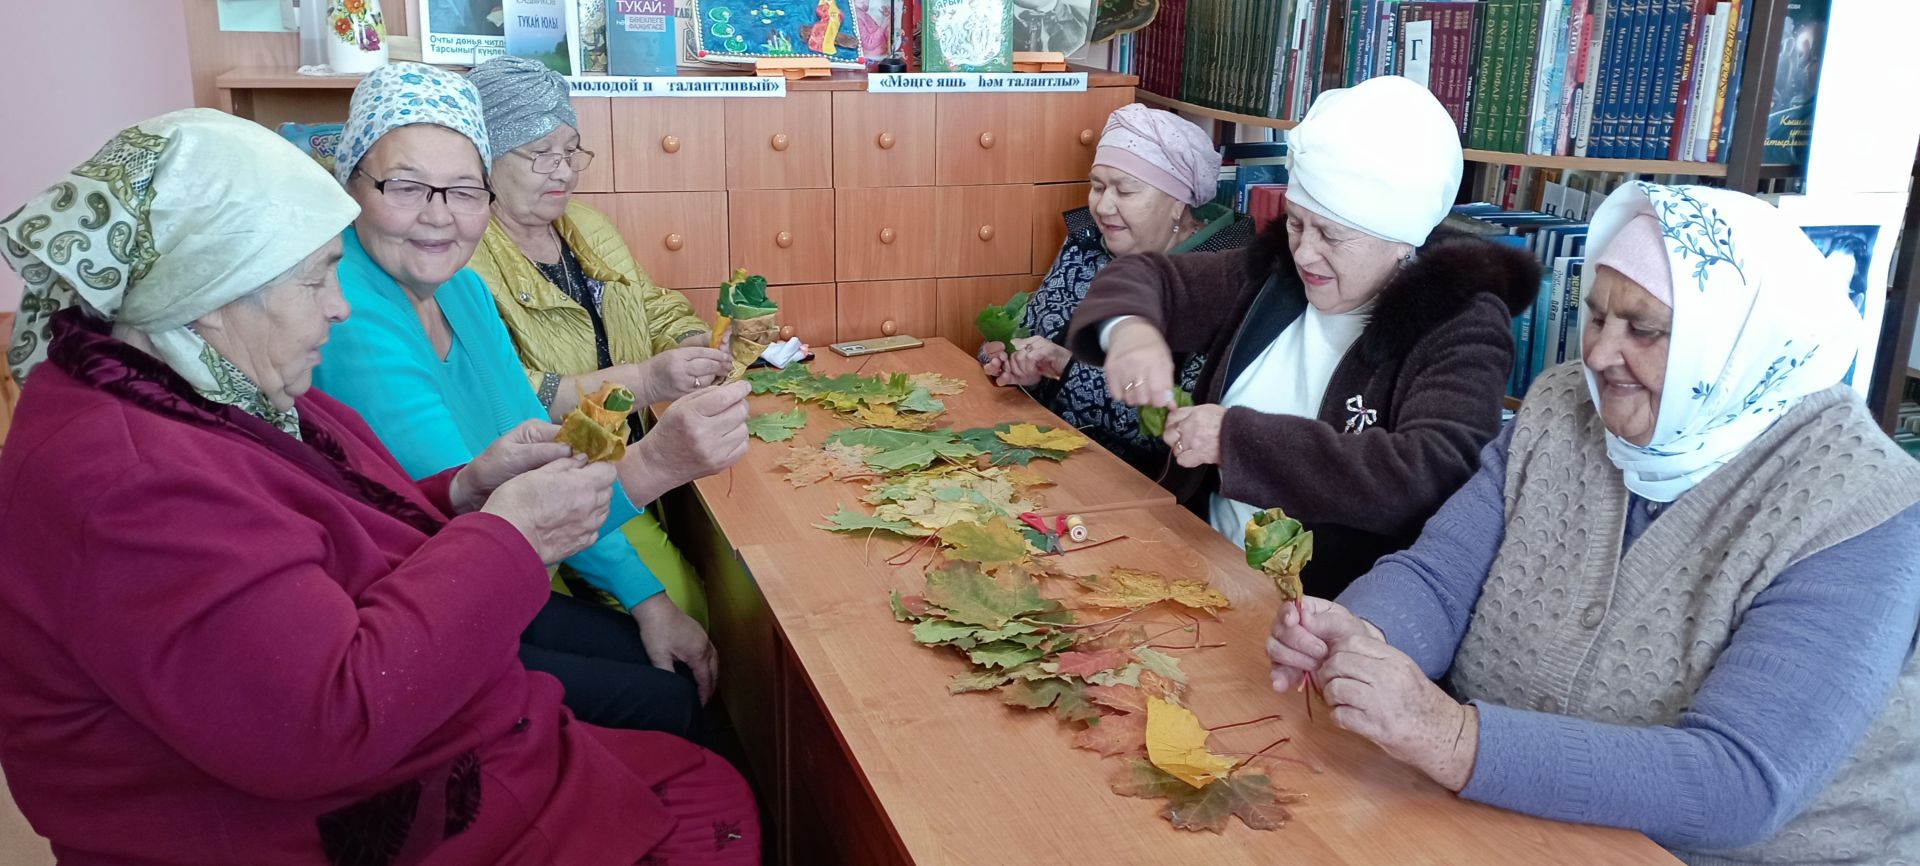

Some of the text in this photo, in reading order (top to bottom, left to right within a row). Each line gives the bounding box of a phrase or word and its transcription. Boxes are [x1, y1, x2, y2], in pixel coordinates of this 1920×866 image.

[517, 14, 559, 30] ТУКАЙ ЮЛЫ
[616, 0, 666, 14] ТУКАЙ:
[430, 35, 453, 44] Очты
[456, 38, 482, 46] дөнья
[1411, 39, 1423, 61] Г
[1520, 18, 1539, 101] ӘХӘТ ГАФФАР
[571, 78, 780, 93] молодой и талантливый»
[880, 75, 1080, 88] «Мәңге яшь һәм талантлы»
[1609, 68, 1620, 105] ГАЛИЕВ
[1623, 67, 1635, 104] ГАЛИЕВ
[1638, 67, 1649, 104] ГАЛИЕВ
[1653, 67, 1664, 105] ГАЛИЕВ
[1669, 65, 1682, 104] ГАЛИЕВ
[1569, 275, 1581, 307] ЭЛМӘК
